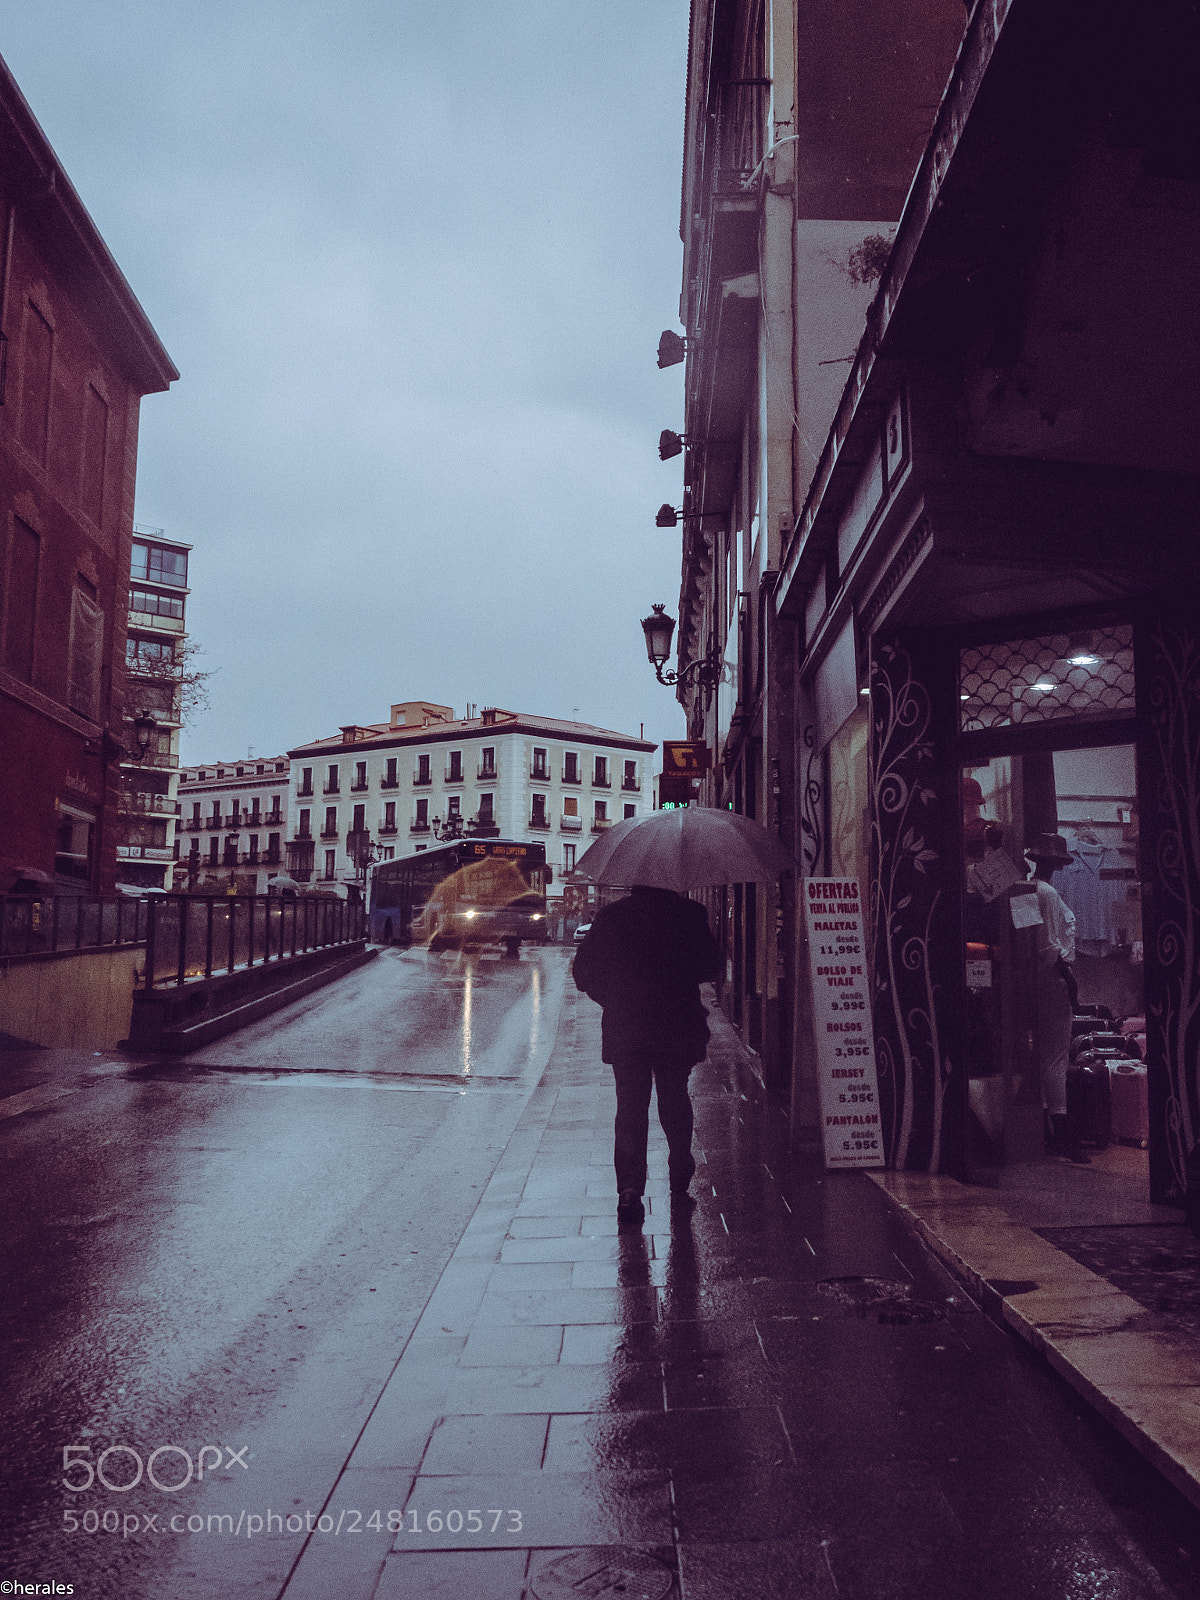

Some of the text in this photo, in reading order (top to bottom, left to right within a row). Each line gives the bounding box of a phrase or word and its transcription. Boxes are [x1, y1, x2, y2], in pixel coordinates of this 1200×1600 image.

[474, 844, 486, 855] 65
[809, 882, 859, 899] OFERTAS
[809, 903, 827, 914] VENTA
[828, 903, 836, 914] AL
[814, 921, 858, 931] MALETAS
[835, 935, 859, 943] desde
[820, 945, 861, 956] 11,99€
[816, 965, 863, 976] BOLSO DE
[827, 976, 854, 987] VIAJE
[840, 991, 864, 1000] desde
[826, 1022, 862, 1033] BOLSOS
[831, 1068, 865, 1079] JERSEY
[826, 1114, 878, 1126] PANTALON
